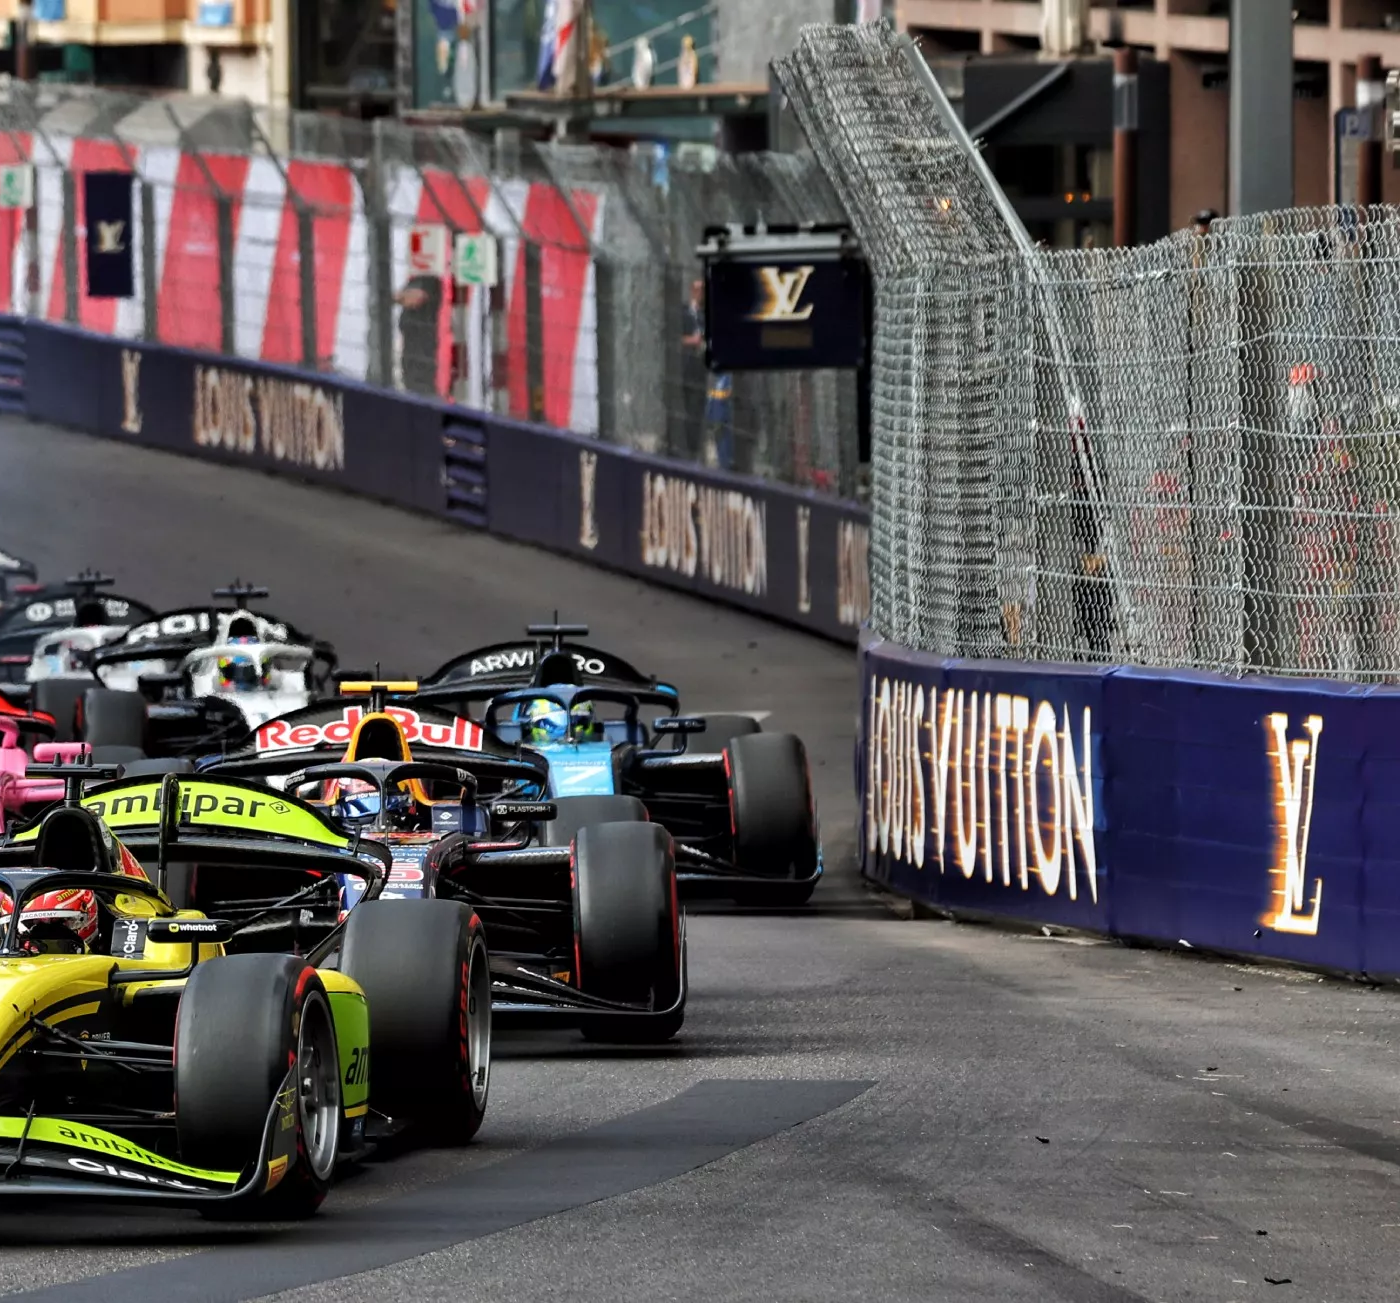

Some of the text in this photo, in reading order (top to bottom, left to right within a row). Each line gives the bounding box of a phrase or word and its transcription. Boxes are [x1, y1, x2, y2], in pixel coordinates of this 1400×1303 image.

[195, 364, 345, 471] LOUIS VUITTON
[256, 705, 484, 751] Red Bull
[868, 673, 1098, 905] LOUIS VUITTON
[24, 911, 57, 919] ACADEMY
[179, 923, 218, 932] whatnot
